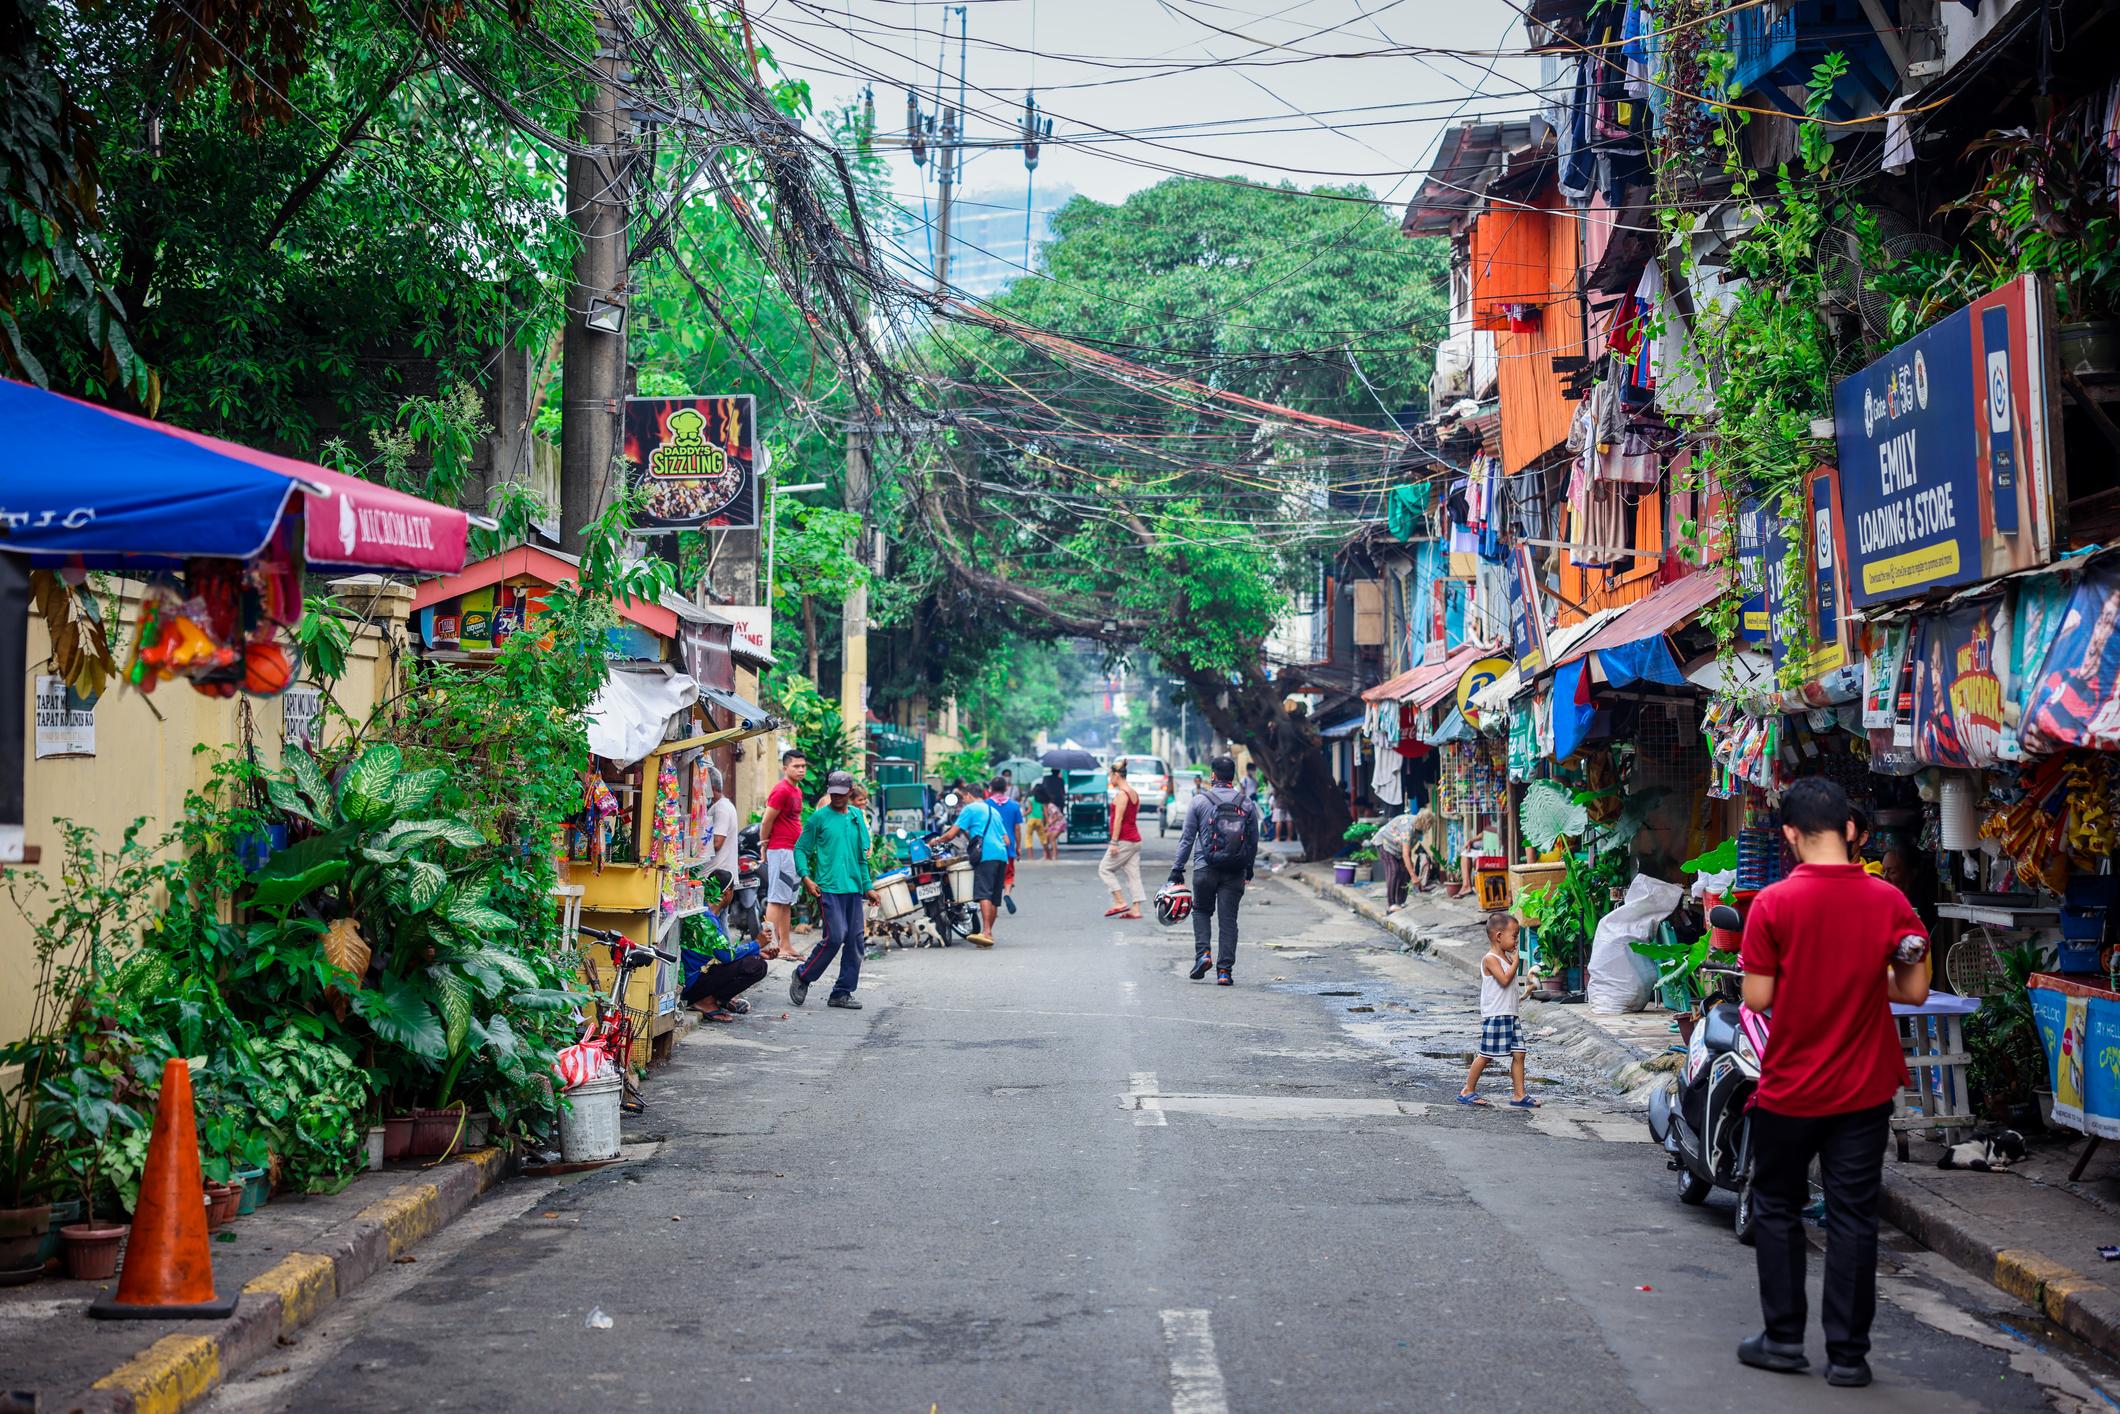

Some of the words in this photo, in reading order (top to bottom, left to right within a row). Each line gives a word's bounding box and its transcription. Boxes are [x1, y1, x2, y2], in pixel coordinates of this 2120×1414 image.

[653, 451, 723, 475] SIZZLING
[664, 446, 711, 456] DADDY'S
[1879, 428, 1918, 496] EMILY
[358, 508, 434, 551] MICROMATIC
[1858, 501, 1906, 554] LOADING
[1905, 497, 1917, 541] &
[1915, 481, 1956, 538] STORE
[1768, 564, 1776, 604] 3
[37, 694, 59, 710] TAPAT
[37, 712, 59, 727] TAPAT
[69, 712, 84, 727] LINIS
[84, 712, 94, 727] KO
